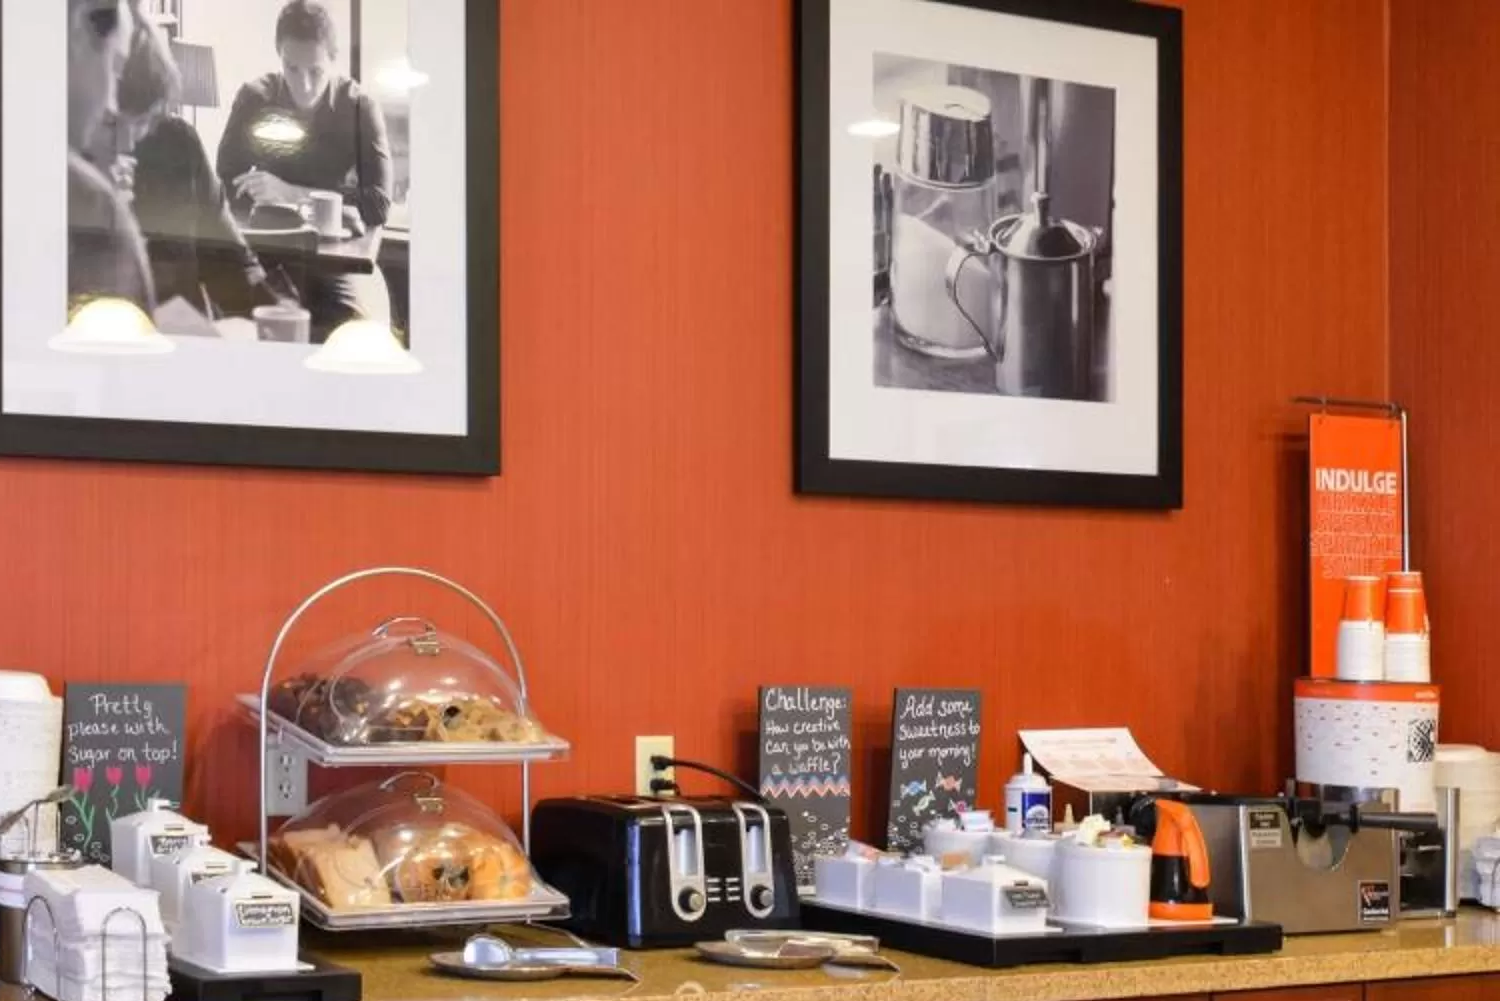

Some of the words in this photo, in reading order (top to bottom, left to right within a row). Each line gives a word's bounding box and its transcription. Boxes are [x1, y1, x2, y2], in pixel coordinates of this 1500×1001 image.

[1315, 467, 1397, 495] INDULGE
[88, 692, 153, 719] Pretty
[765, 687, 846, 720] Challenge:
[900, 694, 935, 719] Add
[937, 700, 972, 718] some
[68, 721, 120, 741] please
[124, 716, 171, 735] with
[765, 720, 789, 736] How
[793, 718, 840, 734] creative
[899, 720, 966, 740] sweetness
[969, 718, 980, 735] to
[117, 747, 138, 762] on
[811, 738, 827, 752] be
[828, 735, 851, 750] with
[899, 747, 925, 769] your
[771, 764, 783, 776] a
